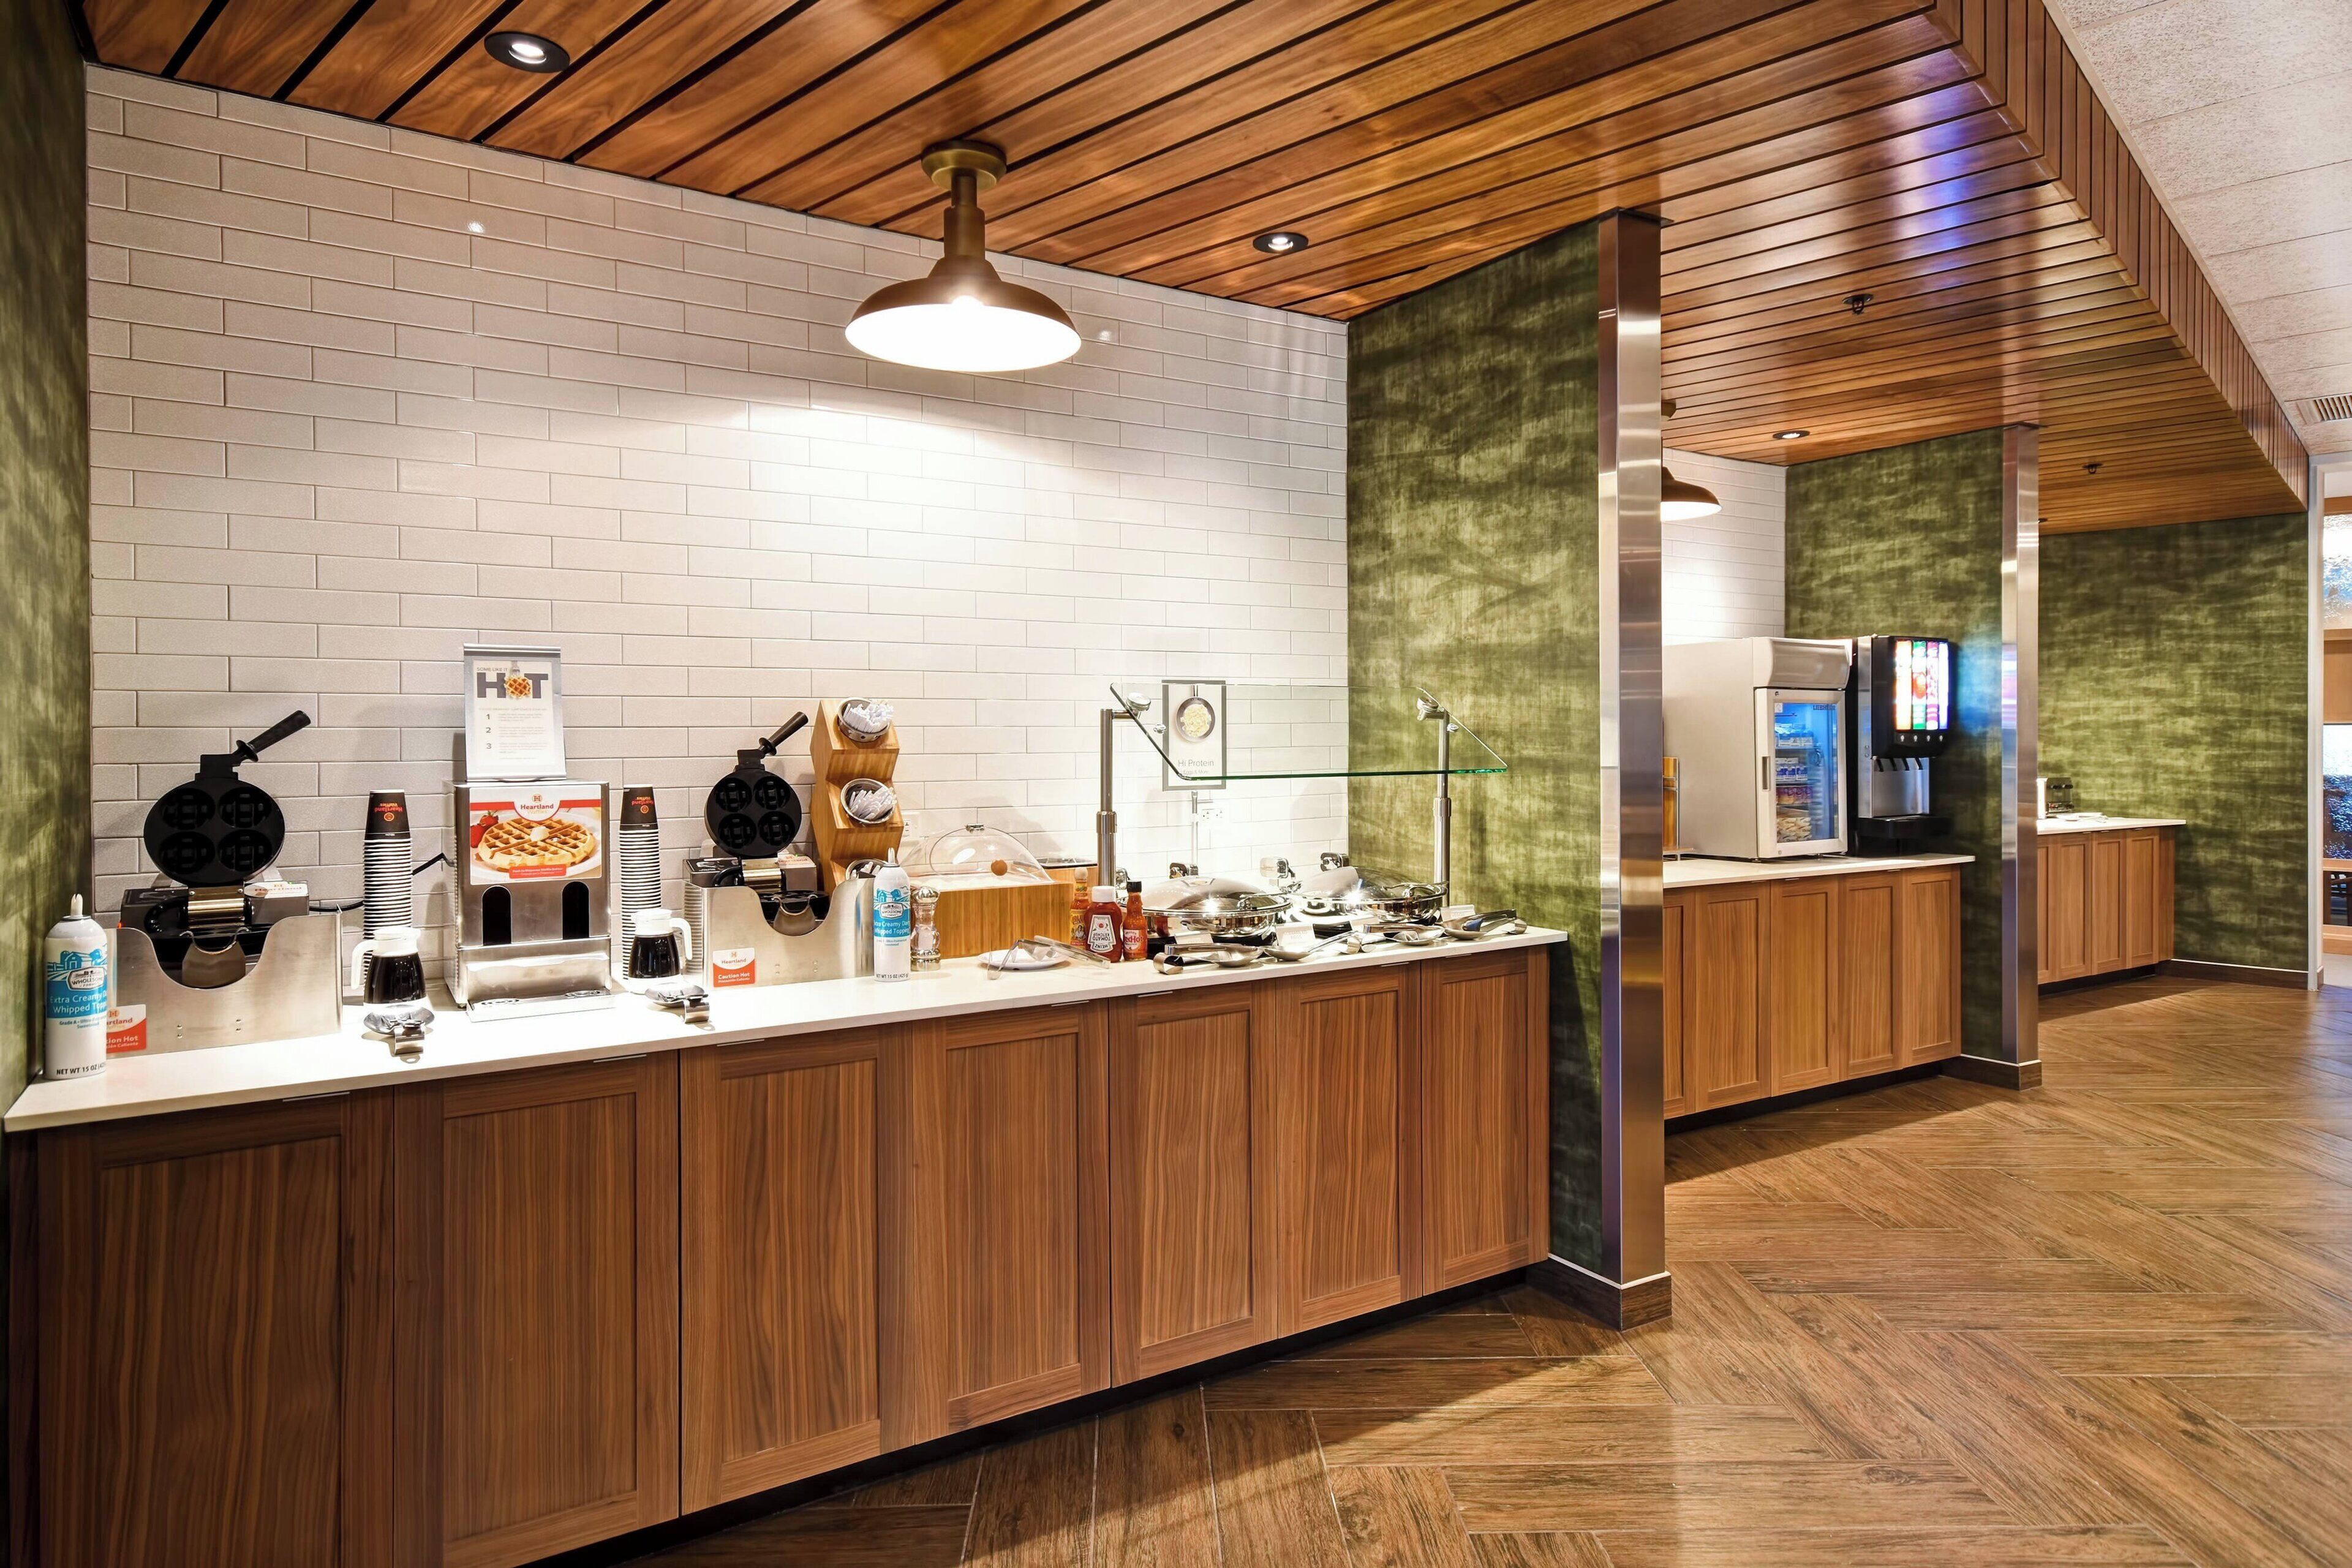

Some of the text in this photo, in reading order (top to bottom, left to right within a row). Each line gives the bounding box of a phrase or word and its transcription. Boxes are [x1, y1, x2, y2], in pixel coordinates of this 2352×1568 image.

[50, 995, 69, 1004] Extra
[72, 992, 103, 1003] Creamy
[53, 1003, 90, 1014] Whipped
[56, 1066, 68, 1076] NET
